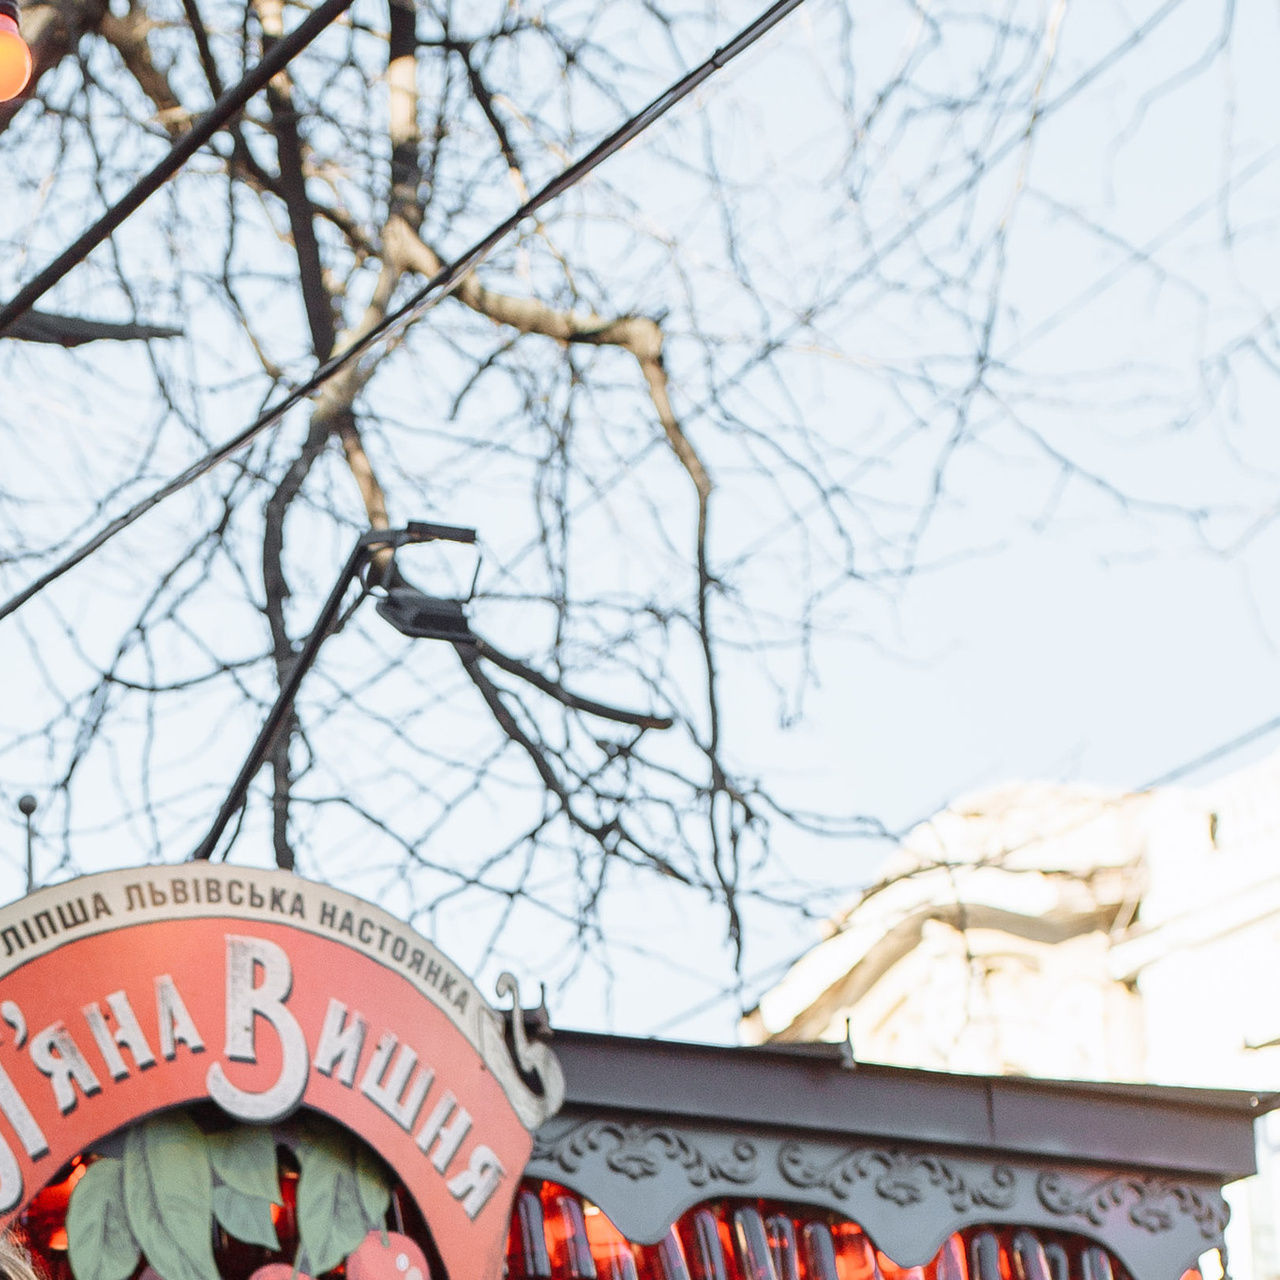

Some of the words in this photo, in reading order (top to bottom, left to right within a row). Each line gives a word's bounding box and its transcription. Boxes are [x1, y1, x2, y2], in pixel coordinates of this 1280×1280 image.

[0, 892, 113, 957] ЛІПША
[124, 877, 306, 921] ЛЬВІВСЬКА
[320, 901, 470, 1016] НАСТОЯНКА
[206, 933, 507, 1223] ВИШНЯ
